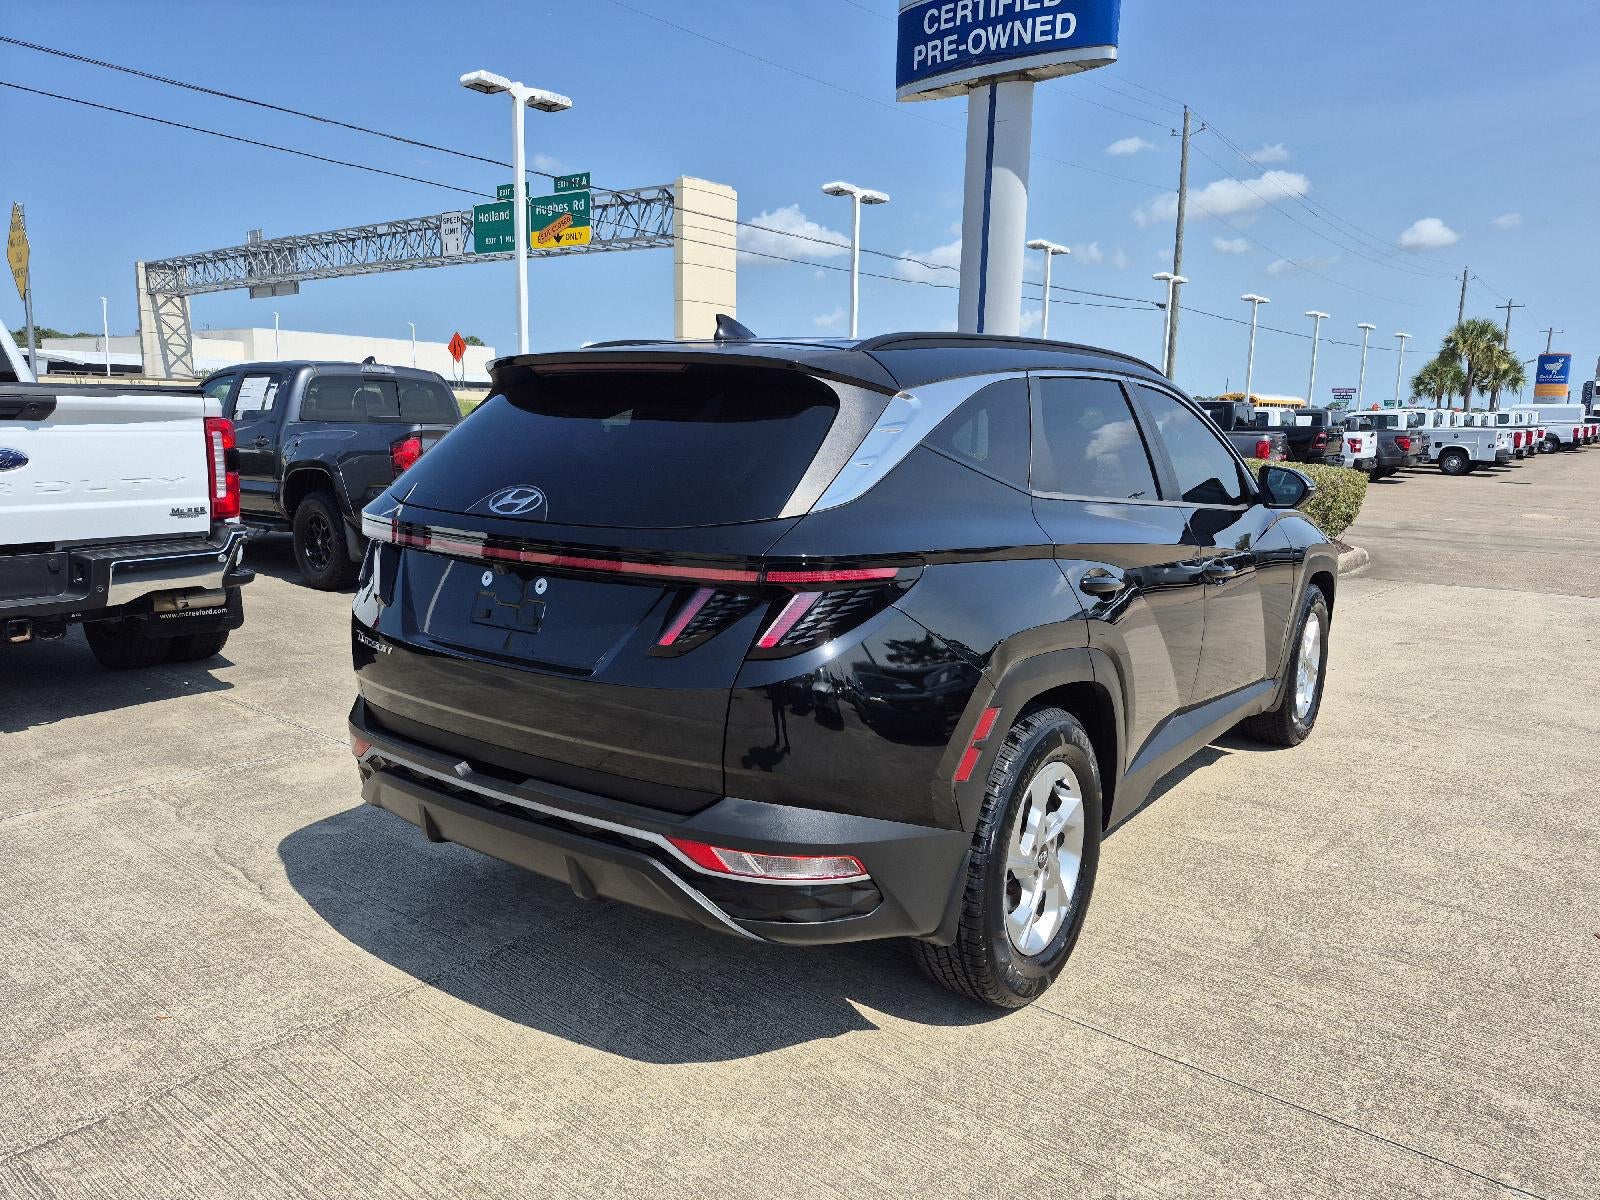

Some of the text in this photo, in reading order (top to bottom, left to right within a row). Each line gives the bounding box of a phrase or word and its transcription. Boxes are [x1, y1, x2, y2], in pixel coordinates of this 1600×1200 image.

[923, 0, 1062, 35] CERTIF
[913, 12, 1077, 71] PRE-OWNED
[500, 188, 511, 197] EXIT
[535, 198, 585, 217] Hughes Rd
[442, 215, 461, 225] SPEED
[478, 209, 510, 223] Holland
[444, 227, 459, 236] LIMIT
[565, 232, 583, 241] ONLY
[485, 237, 497, 245] EXIT
